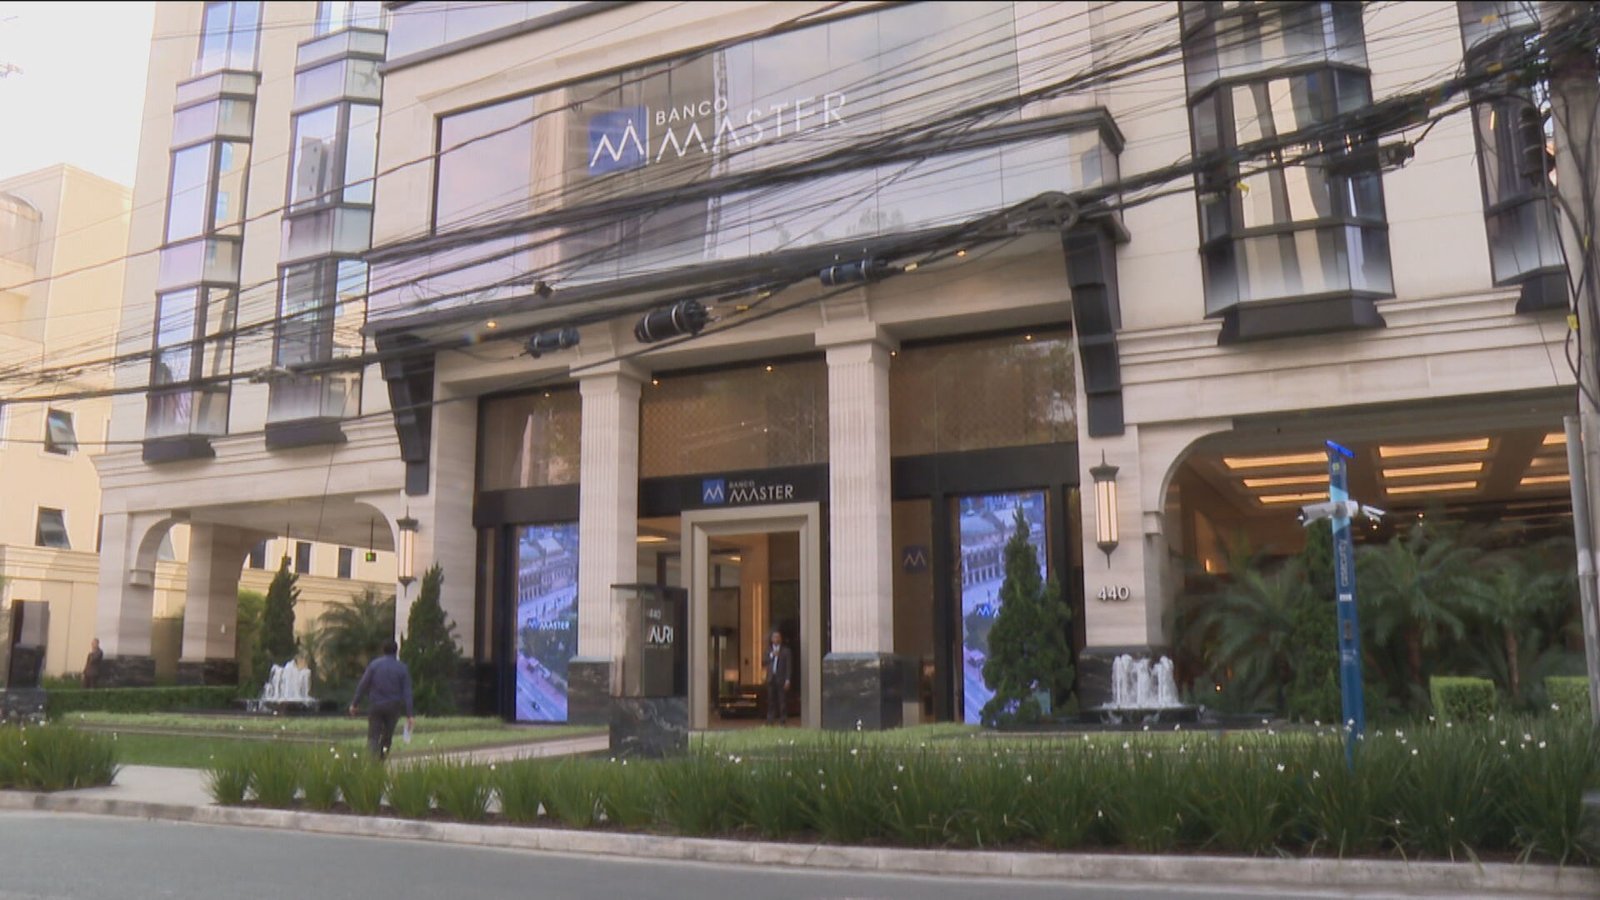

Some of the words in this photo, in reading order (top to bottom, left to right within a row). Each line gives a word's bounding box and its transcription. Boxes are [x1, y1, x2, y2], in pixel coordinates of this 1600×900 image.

[655, 97, 728, 126] BANCO
[655, 92, 848, 163] MASTER
[729, 484, 794, 503] MASTER
[1097, 584, 1131, 602] 440
[539, 618, 570, 631] MASTER
[648, 624, 674, 644] AURI
